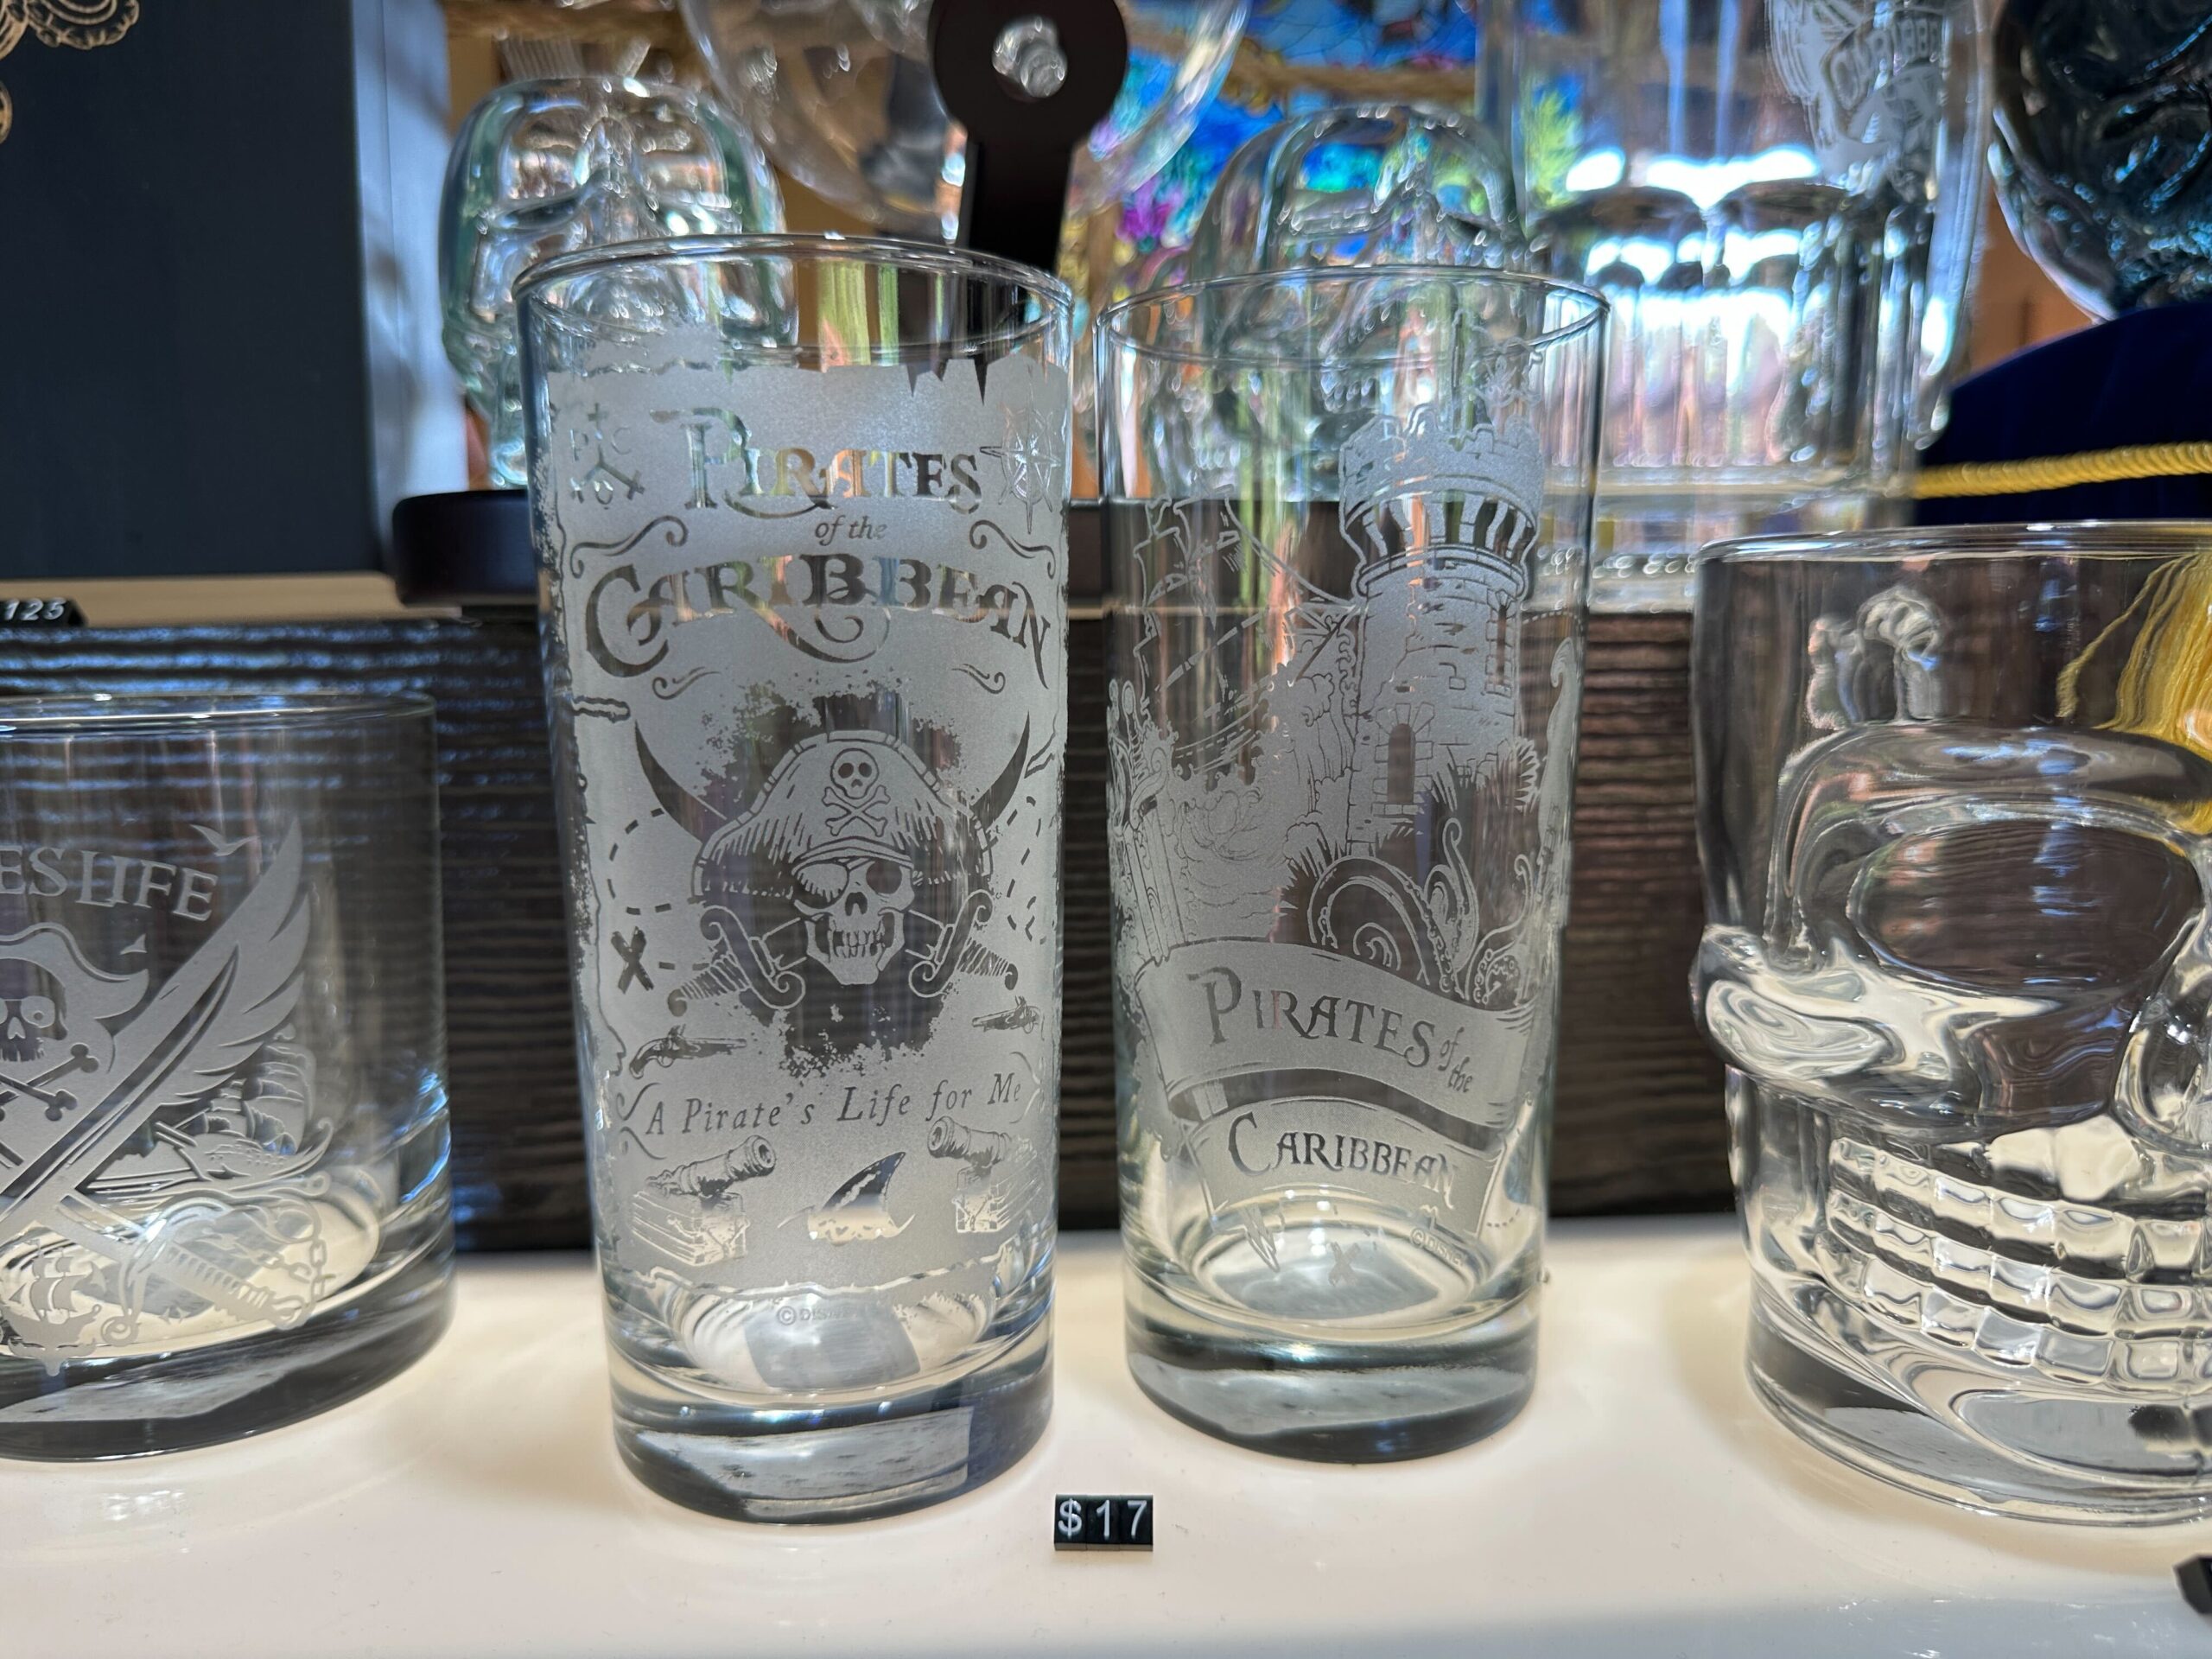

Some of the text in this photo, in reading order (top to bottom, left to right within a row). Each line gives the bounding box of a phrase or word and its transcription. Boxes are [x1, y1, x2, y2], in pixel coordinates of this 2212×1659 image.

[649, 406, 982, 518] PIRATES
[815, 514, 887, 546] of the
[585, 553, 1052, 690] CARIBBEAN
[1188, 966, 1473, 1093] PIRATES of the
[645, 1072, 1021, 1135] A Pirate's Life for Me
[1227, 1111, 1459, 1210] CARIBBEAN
[1058, 1498, 1147, 1540] $17
